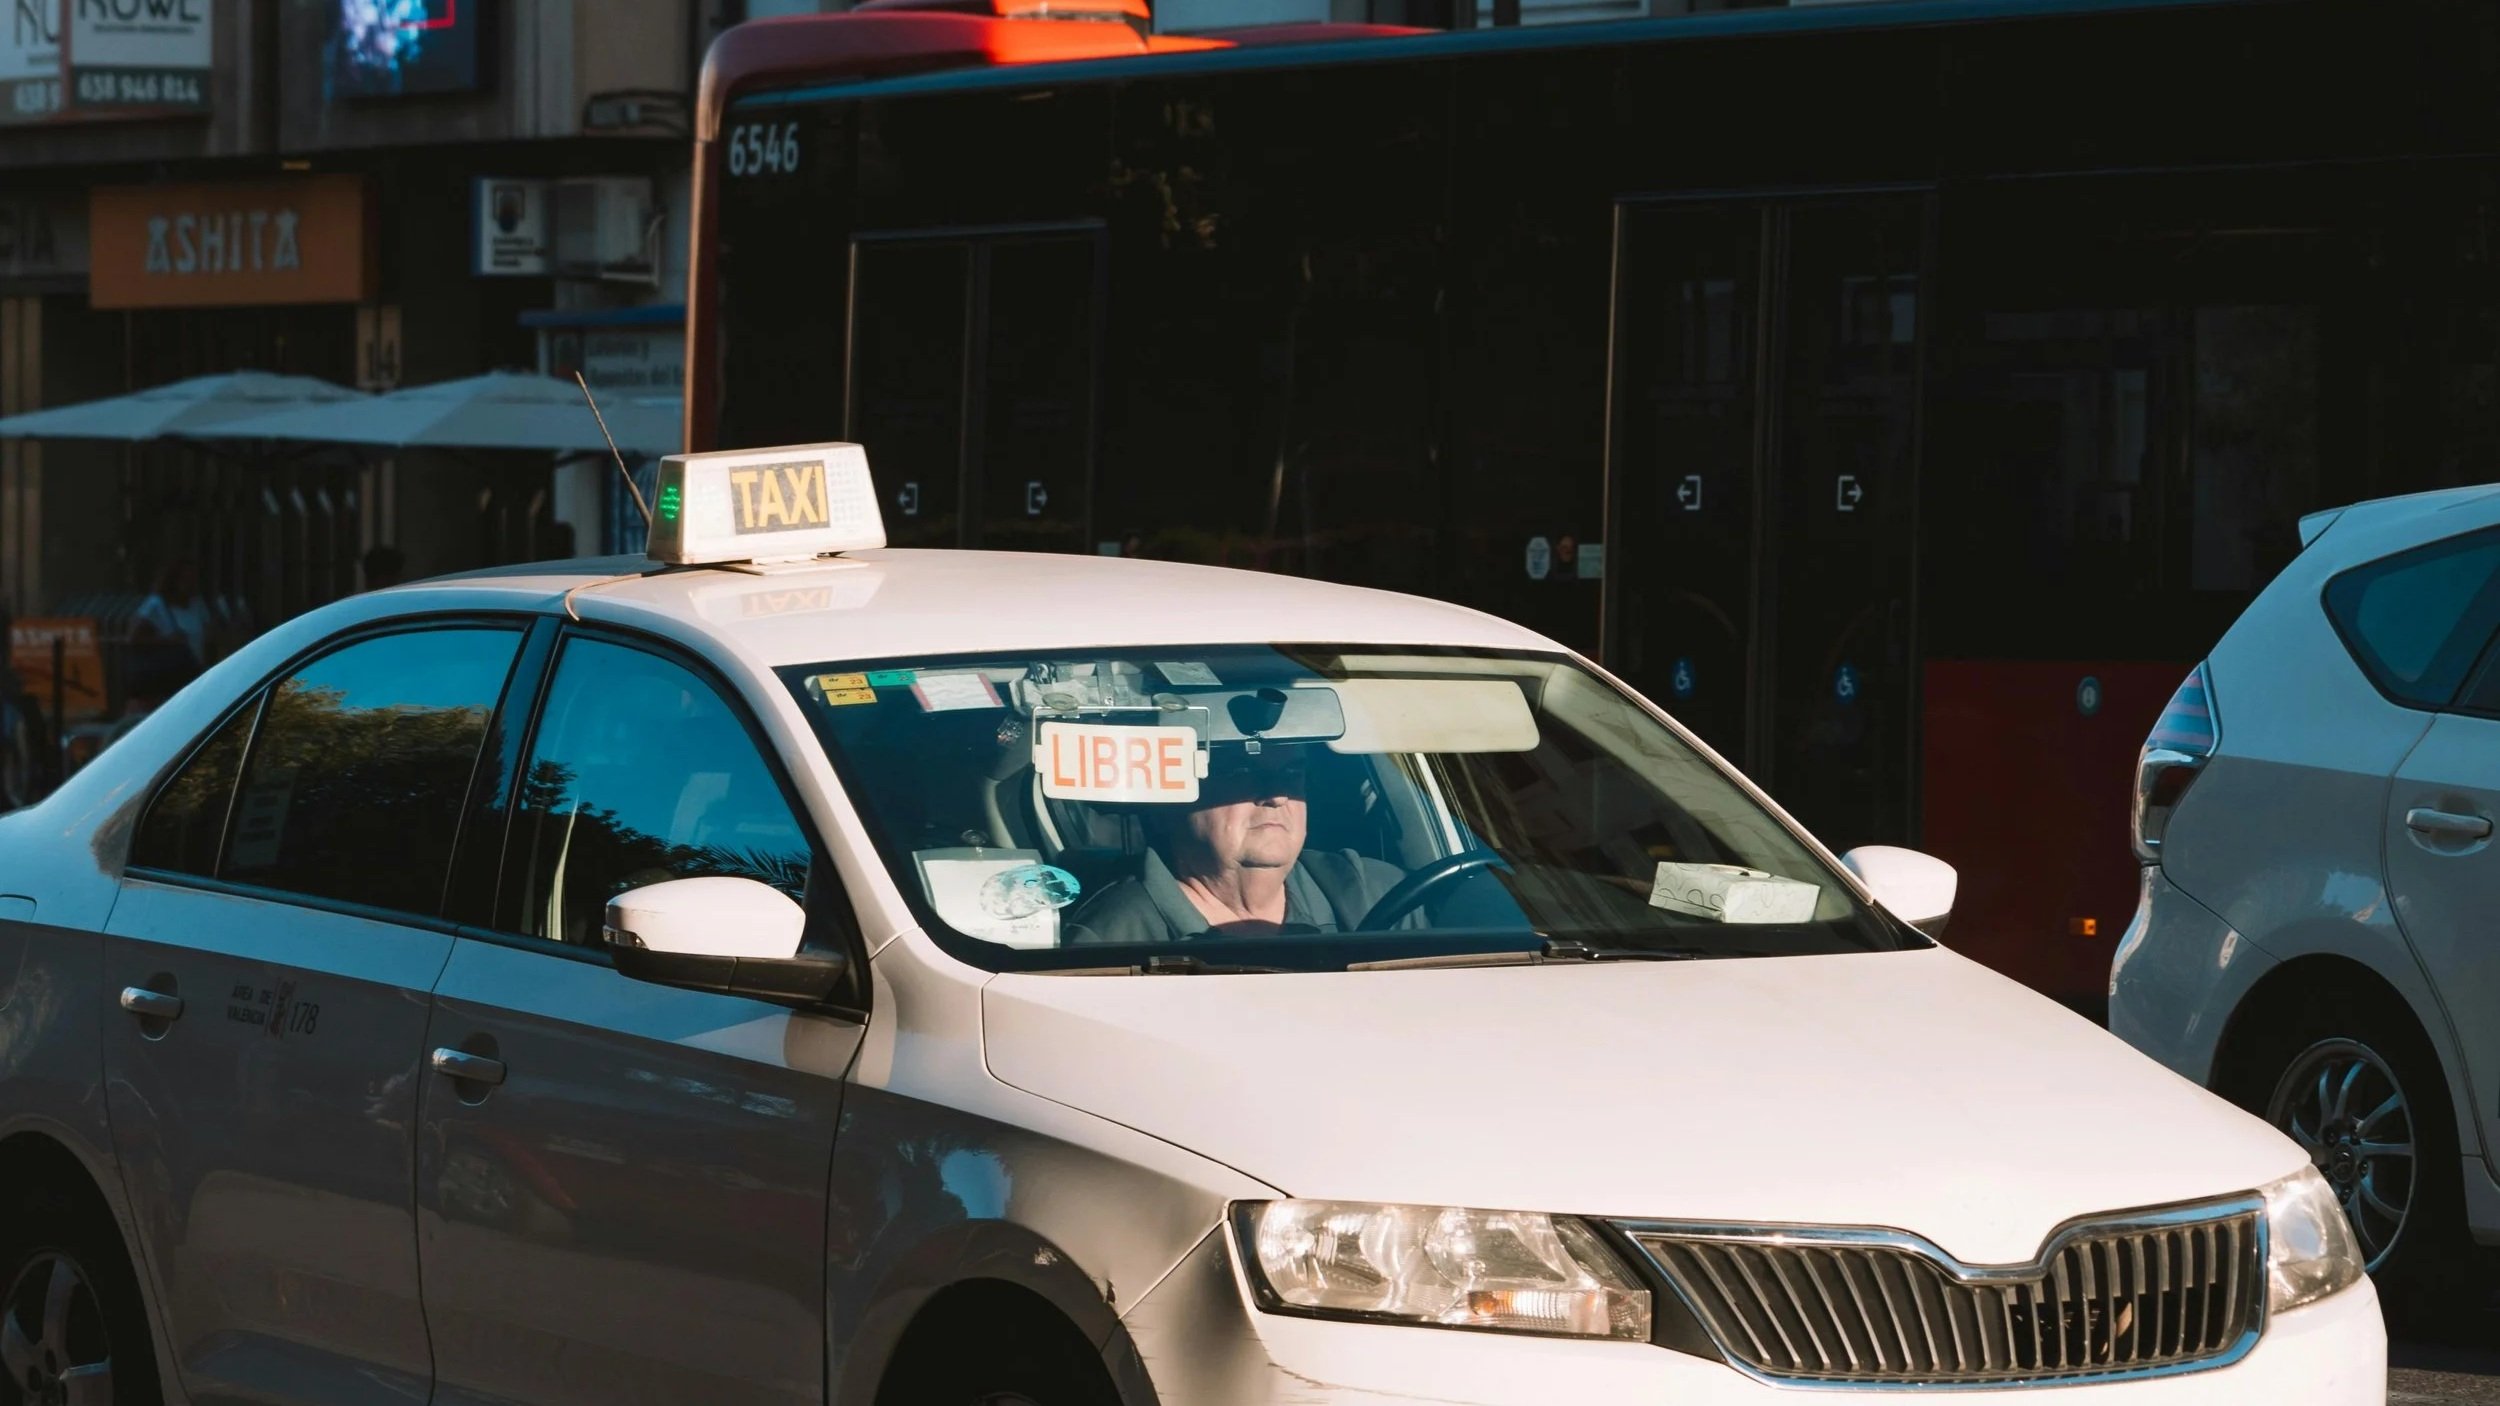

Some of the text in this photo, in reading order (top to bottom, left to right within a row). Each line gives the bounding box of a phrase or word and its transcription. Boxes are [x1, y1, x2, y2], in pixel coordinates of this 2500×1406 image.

[730, 121, 800, 176] 6546
[145, 208, 300, 273] ASHITA
[731, 466, 828, 528] TAXI
[1052, 734, 1185, 789] LIBRE
[290, 1002, 319, 1035] 178
